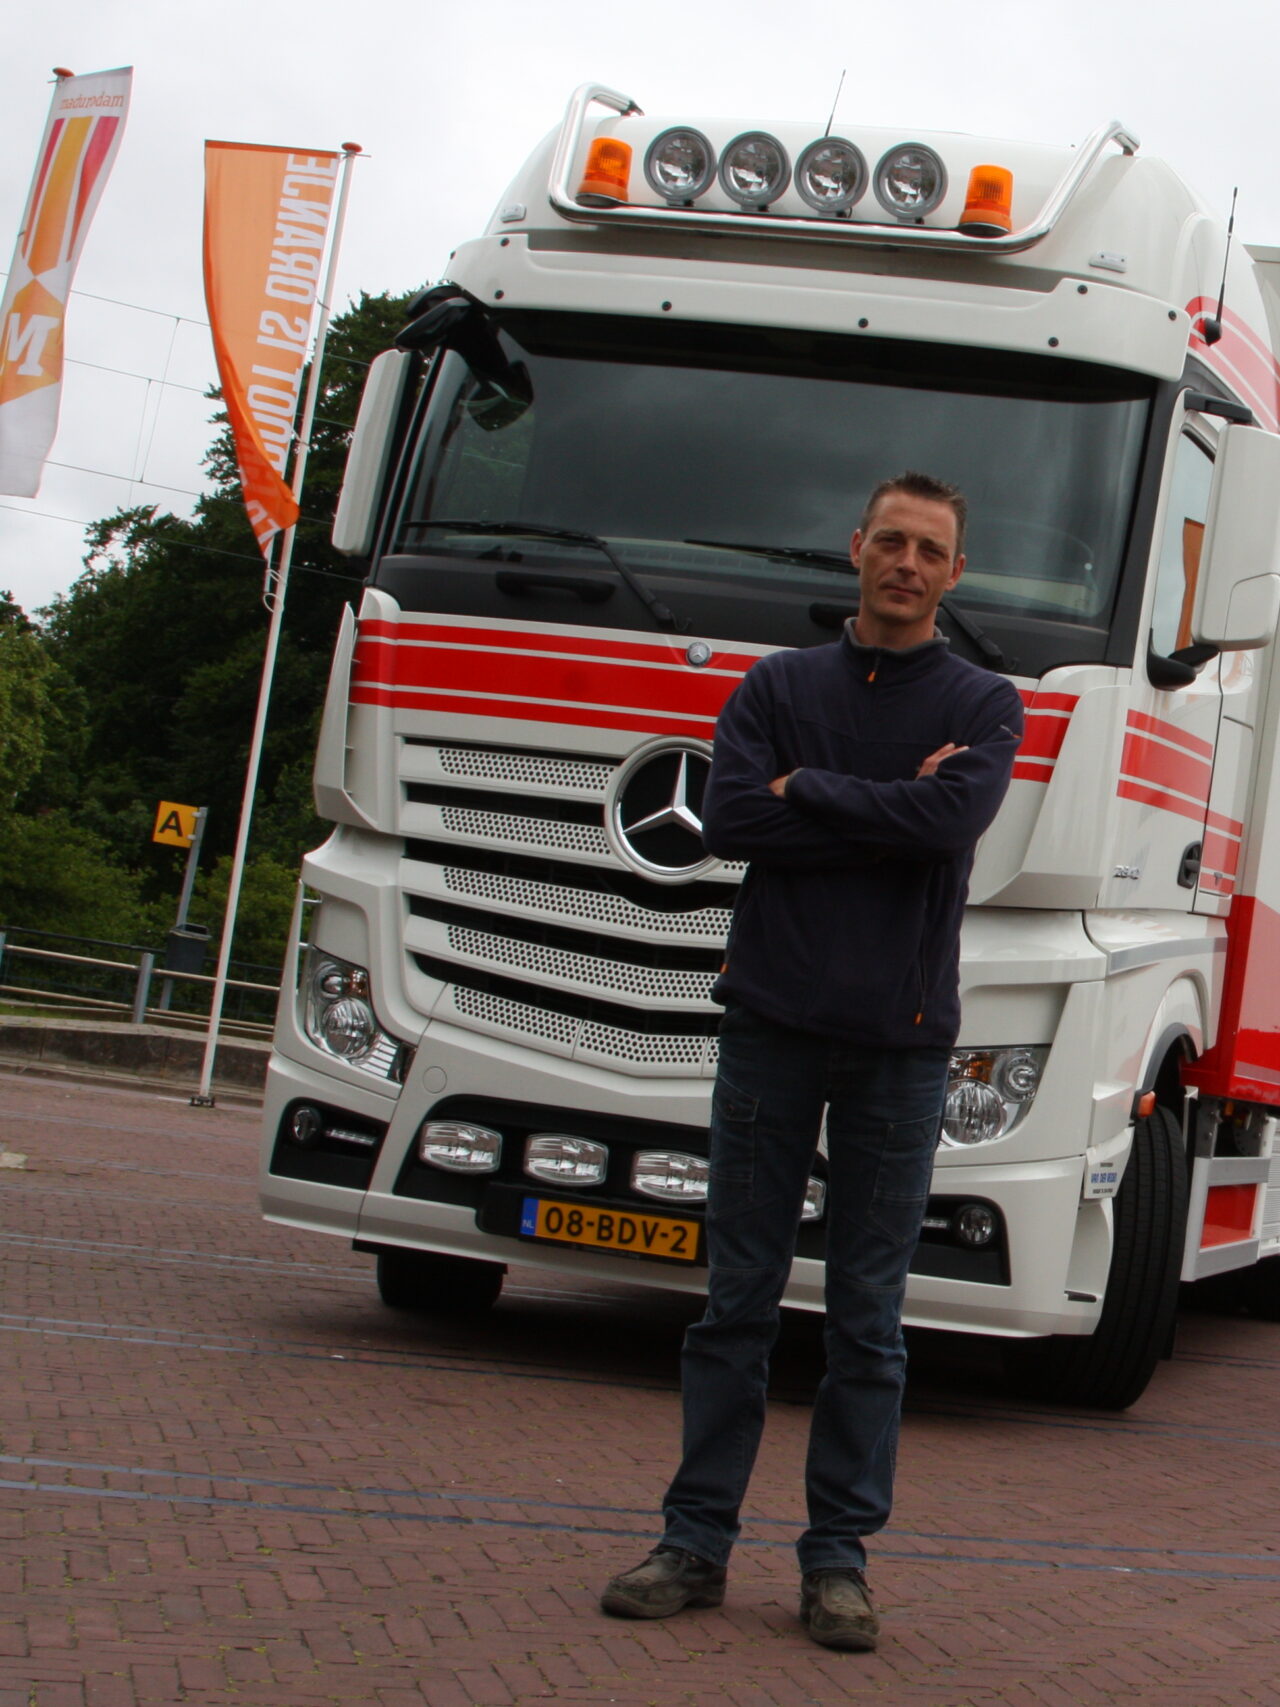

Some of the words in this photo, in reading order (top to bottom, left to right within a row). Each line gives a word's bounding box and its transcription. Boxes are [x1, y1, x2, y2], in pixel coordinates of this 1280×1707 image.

[158, 810, 183, 838] A
[522, 1219, 534, 1230] NL
[545, 1206, 688, 1253] 08-BDV-2
